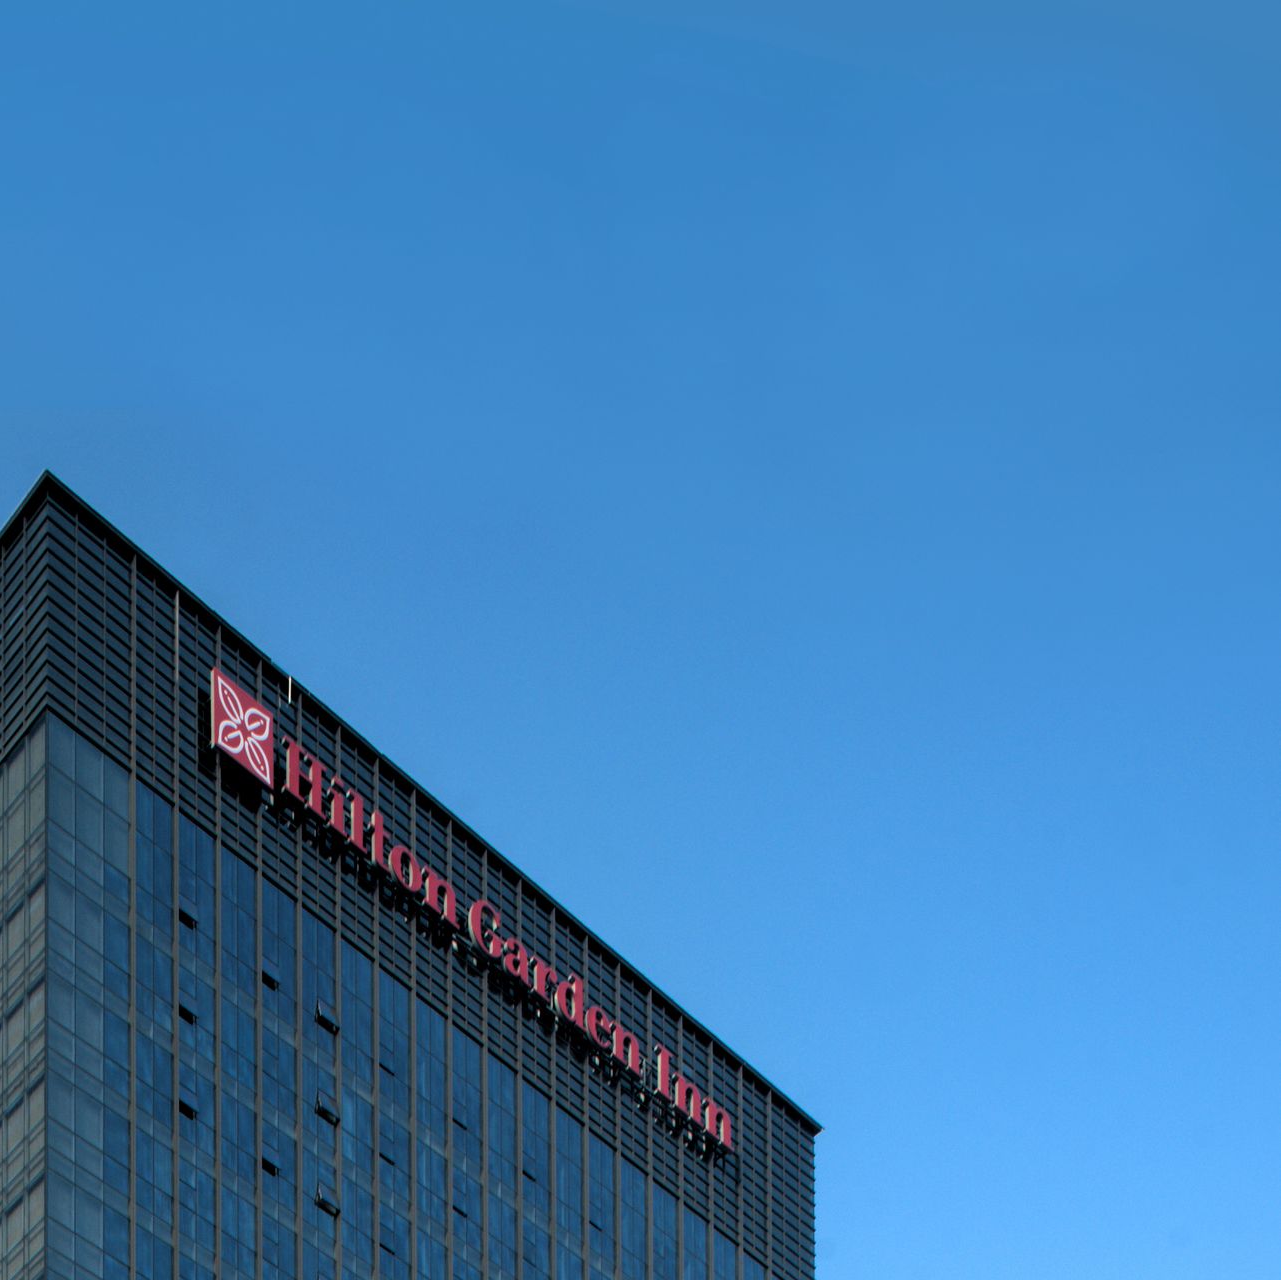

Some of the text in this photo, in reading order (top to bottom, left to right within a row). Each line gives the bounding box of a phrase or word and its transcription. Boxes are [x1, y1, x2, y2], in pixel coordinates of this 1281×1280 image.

[281, 735, 735, 1152] Hilton Garden Inn
